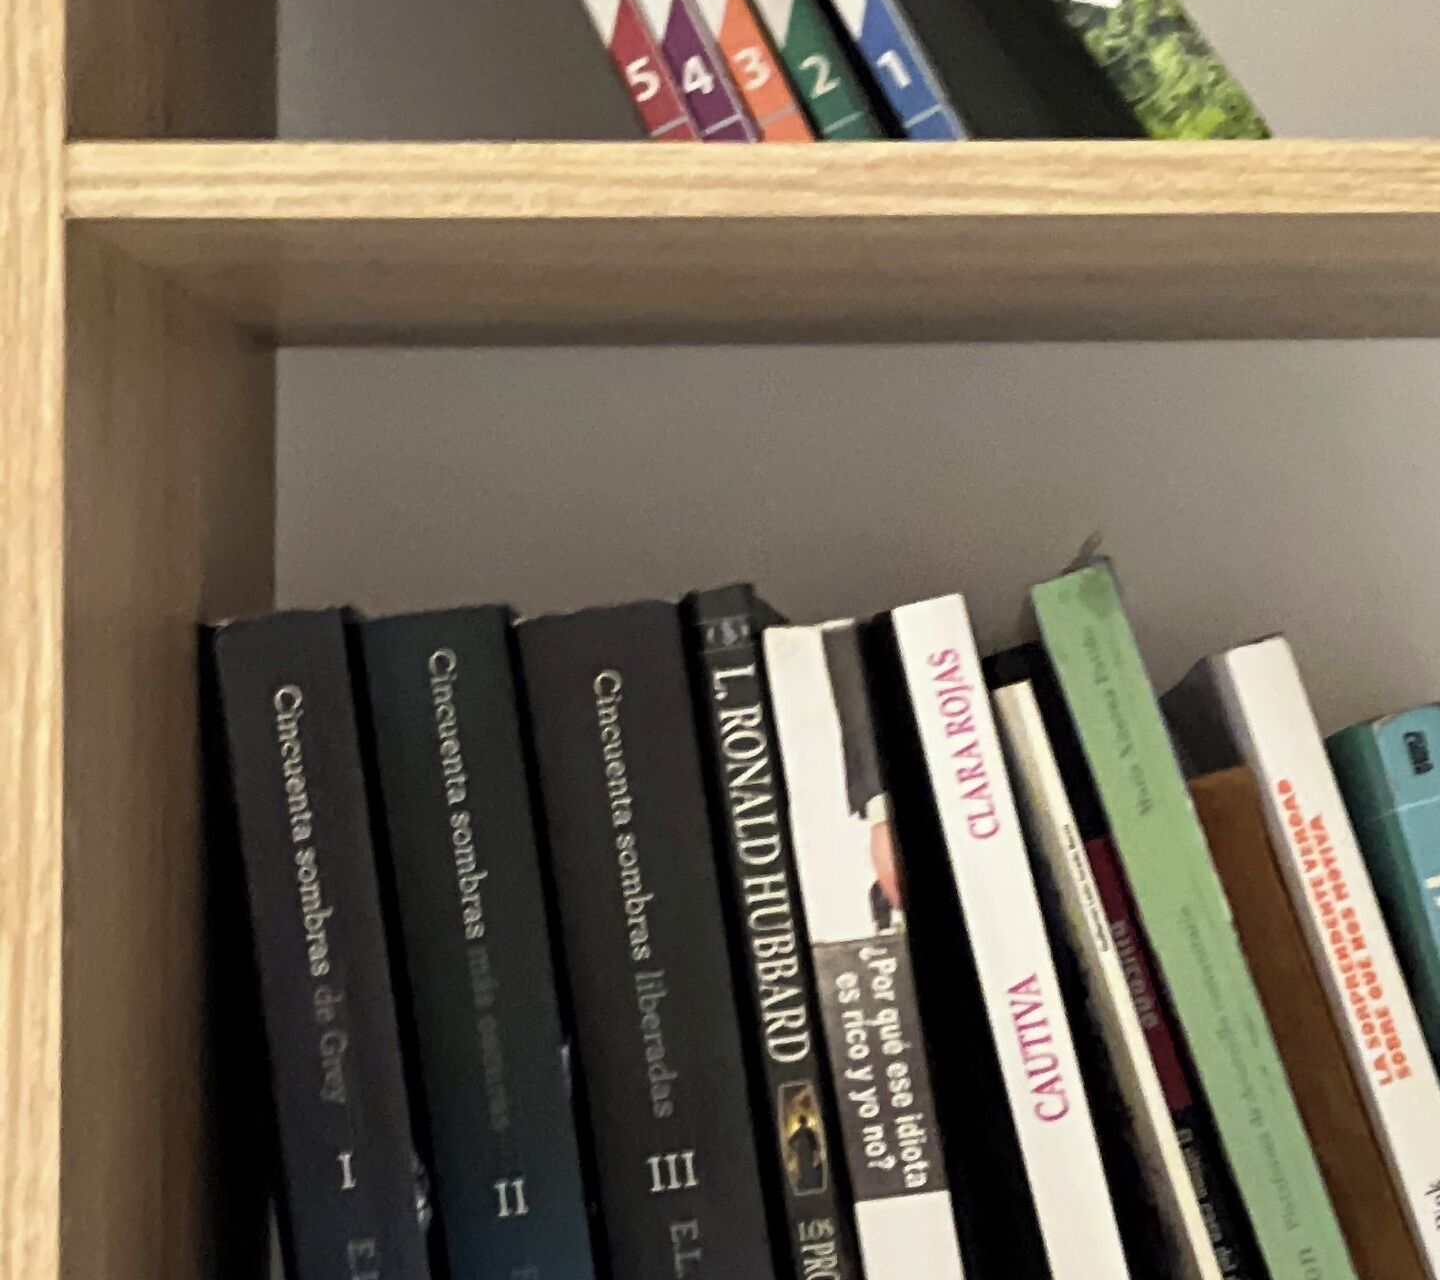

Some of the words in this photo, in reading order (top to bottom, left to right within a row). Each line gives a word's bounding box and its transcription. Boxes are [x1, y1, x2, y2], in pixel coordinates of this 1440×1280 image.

[626, 56, 661, 102] 5
[682, 55, 715, 94] 4
[732, 45, 771, 90] 3
[800, 55, 841, 99] 2
[876, 49, 911, 88] 1
[713, 663, 755, 701] L.
[928, 648, 975, 738] ROJAS
[428, 648, 475, 806] Cincuenta
[593, 669, 641, 828] Cincuenta
[273, 684, 322, 843] Cincuenta
[718, 704, 781, 865] RONALD
[951, 739, 1001, 840] CLARA
[1278, 779, 1318, 873] VERDAD
[449, 811, 489, 940] sombras
[1309, 815, 1348, 902] MOTIVA
[294, 848, 342, 977] sombras
[615, 832, 654, 961] sombras
[1341, 907, 1366, 951] NOS
[743, 871, 811, 1063] HUBBARD
[835, 972, 861, 1004] es
[858, 945, 898, 1001] ¿Por
[1311, 877, 1381, 1049] SORPRENDENTE
[313, 986, 343, 1023] de
[868, 1007, 910, 1055] qué
[634, 969, 679, 1118] liberadas
[841, 1009, 871, 1060] rico
[1006, 973, 1070, 1123] CAUTIVA
[1375, 1007, 1411, 1079] SOBRE
[844, 1065, 874, 1087] y
[886, 1062, 914, 1108] ese
[1373, 1054, 1393, 1085] LA
[847, 1086, 881, 1119] yo
[647, 1150, 698, 1193] III
[862, 1124, 897, 1170] no?
[894, 1112, 938, 1188] idiota
[494, 1178, 528, 1217] II
